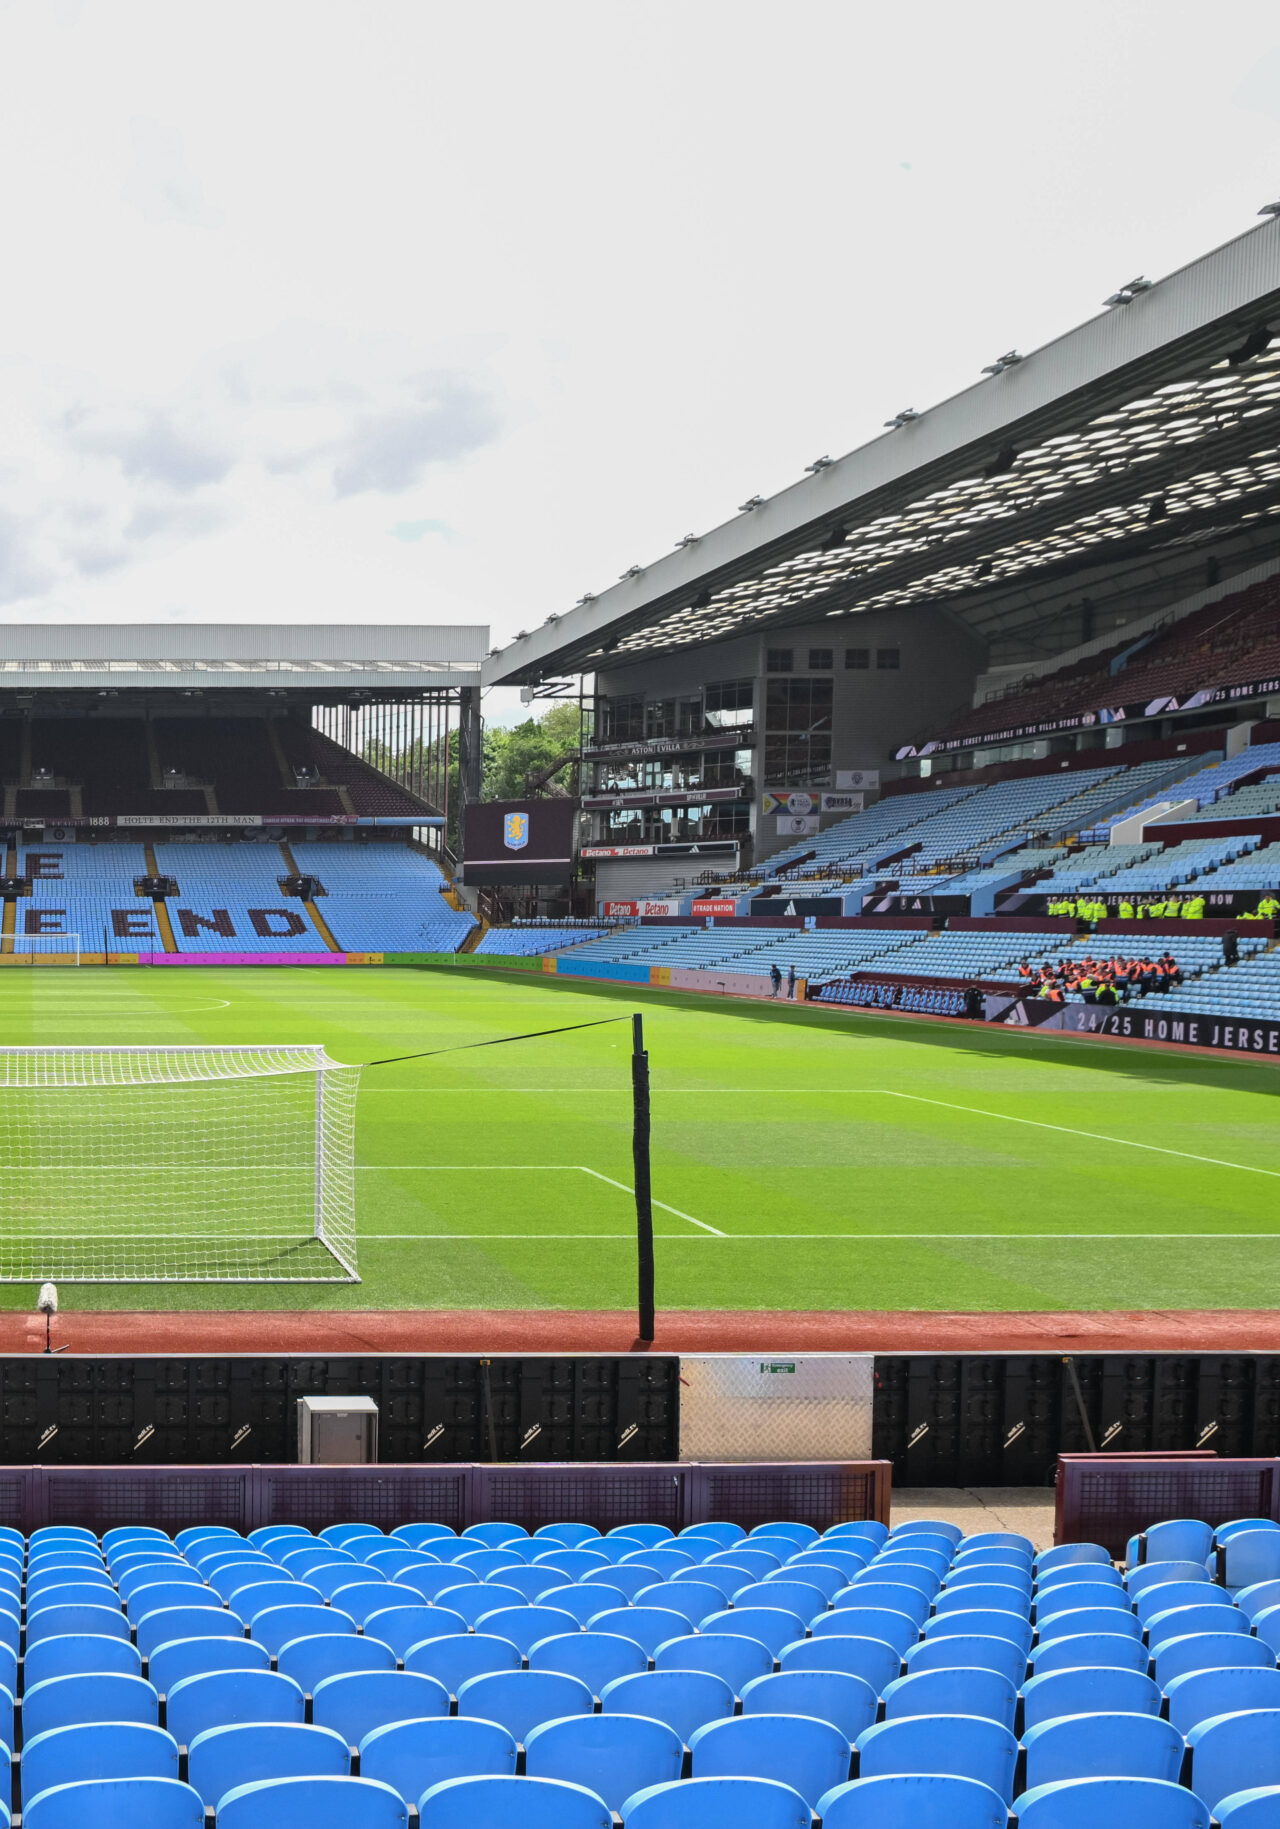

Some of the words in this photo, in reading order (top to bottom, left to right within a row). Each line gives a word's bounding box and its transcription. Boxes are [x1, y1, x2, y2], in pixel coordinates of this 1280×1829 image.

[1230, 685, 1254, 698] HOME
[631, 746, 654, 755] ASTON
[661, 743, 681, 752] VILLA
[90, 816, 110, 826] 1888
[124, 816, 153, 824] HOLTE
[159, 816, 179, 824] END
[183, 816, 202, 824] THE
[206, 816, 228, 824] 12TH
[233, 816, 255, 824] MAN
[623, 848, 649, 856] Betano
[1209, 894, 1234, 905] NOW
[609, 902, 631, 916] Betano
[644, 901, 669, 916] Betano
[111, 908, 308, 938] END
[1077, 1012, 1132, 1035] 24/25
[1144, 1018, 1199, 1043] HOME
